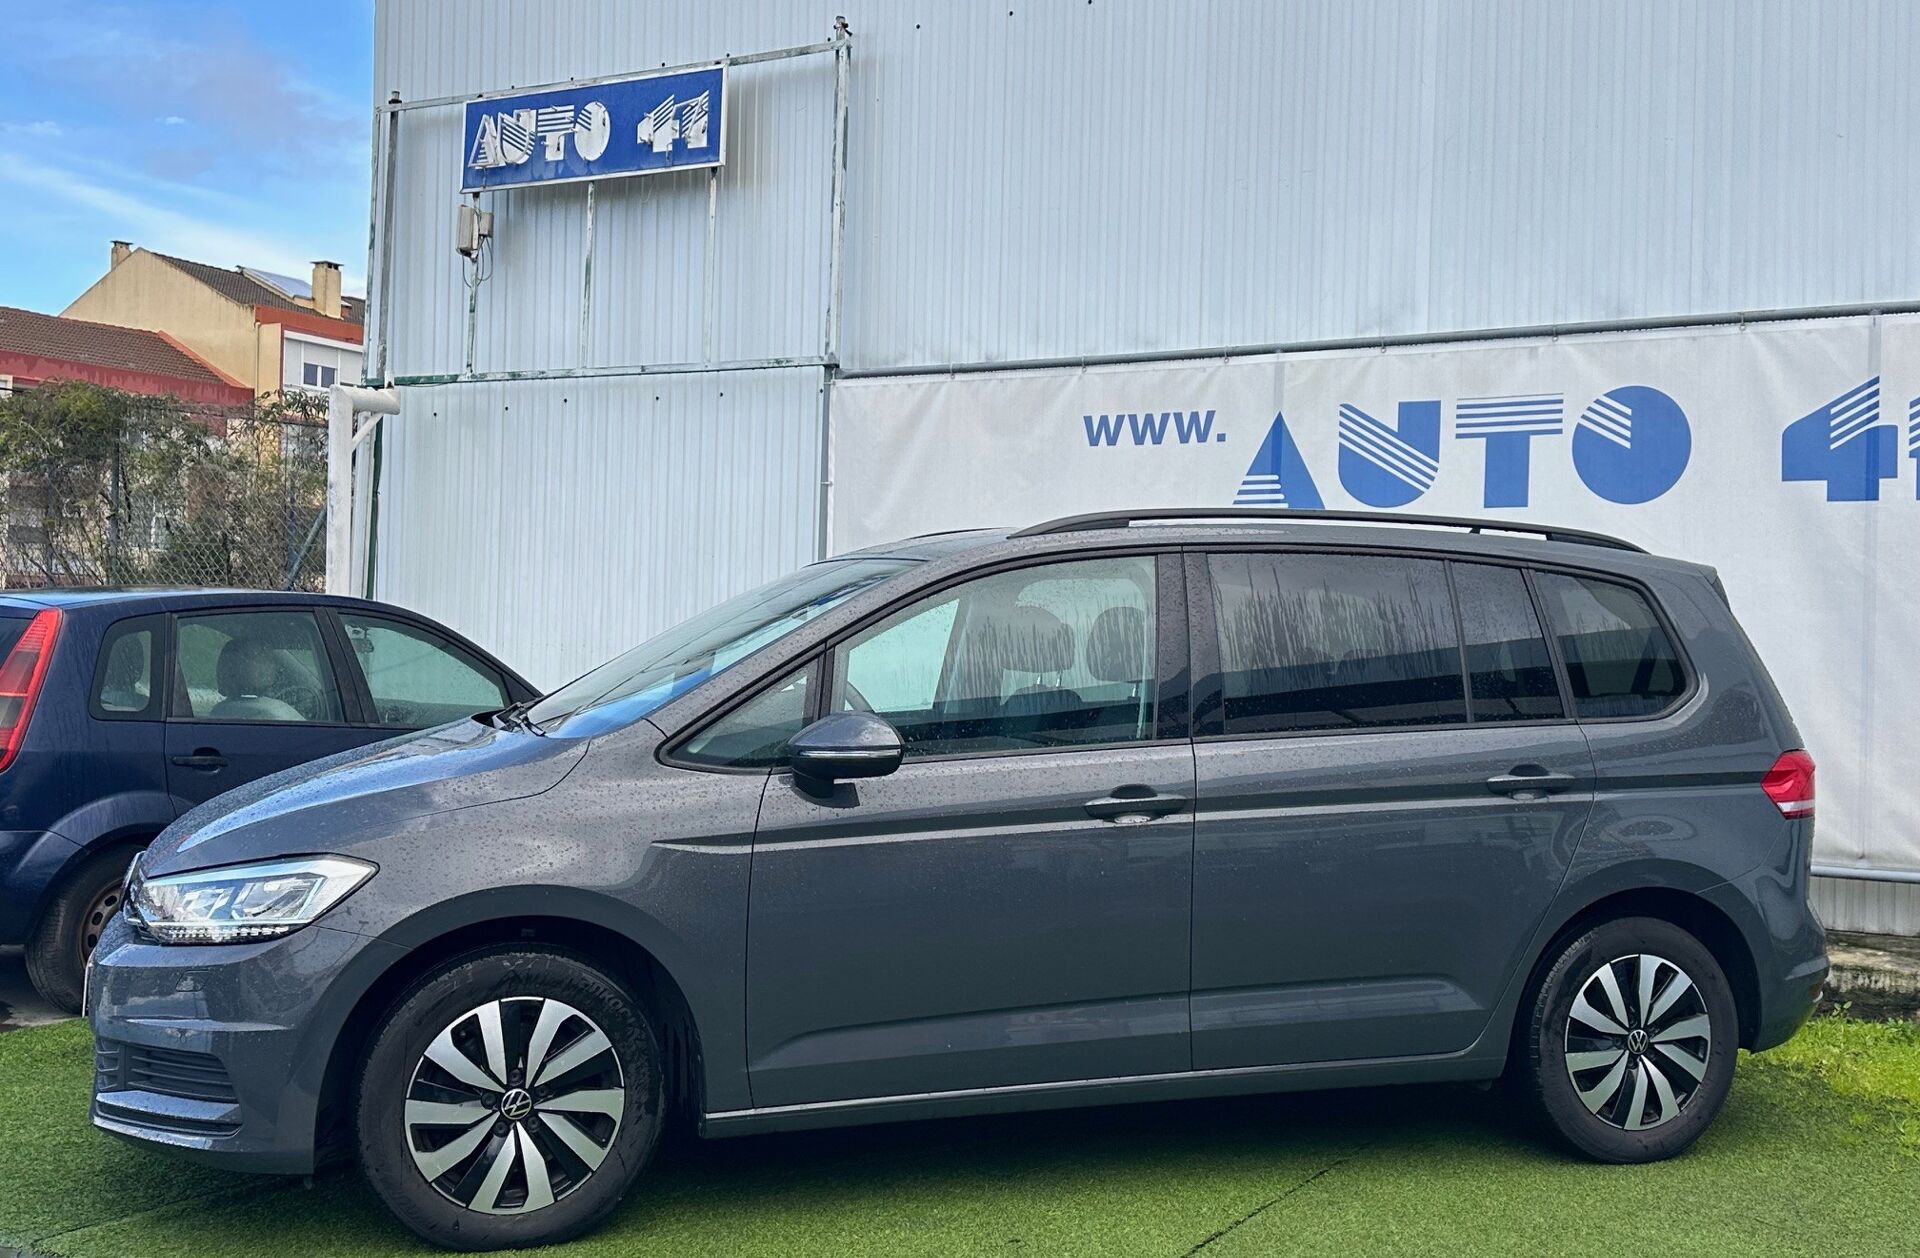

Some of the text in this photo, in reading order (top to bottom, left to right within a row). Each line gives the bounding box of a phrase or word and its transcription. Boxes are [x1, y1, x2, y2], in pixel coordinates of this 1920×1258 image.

[468, 90, 709, 170] AUTO 41
[1232, 384, 1692, 509] AUTO
[1782, 374, 1920, 502] 4
